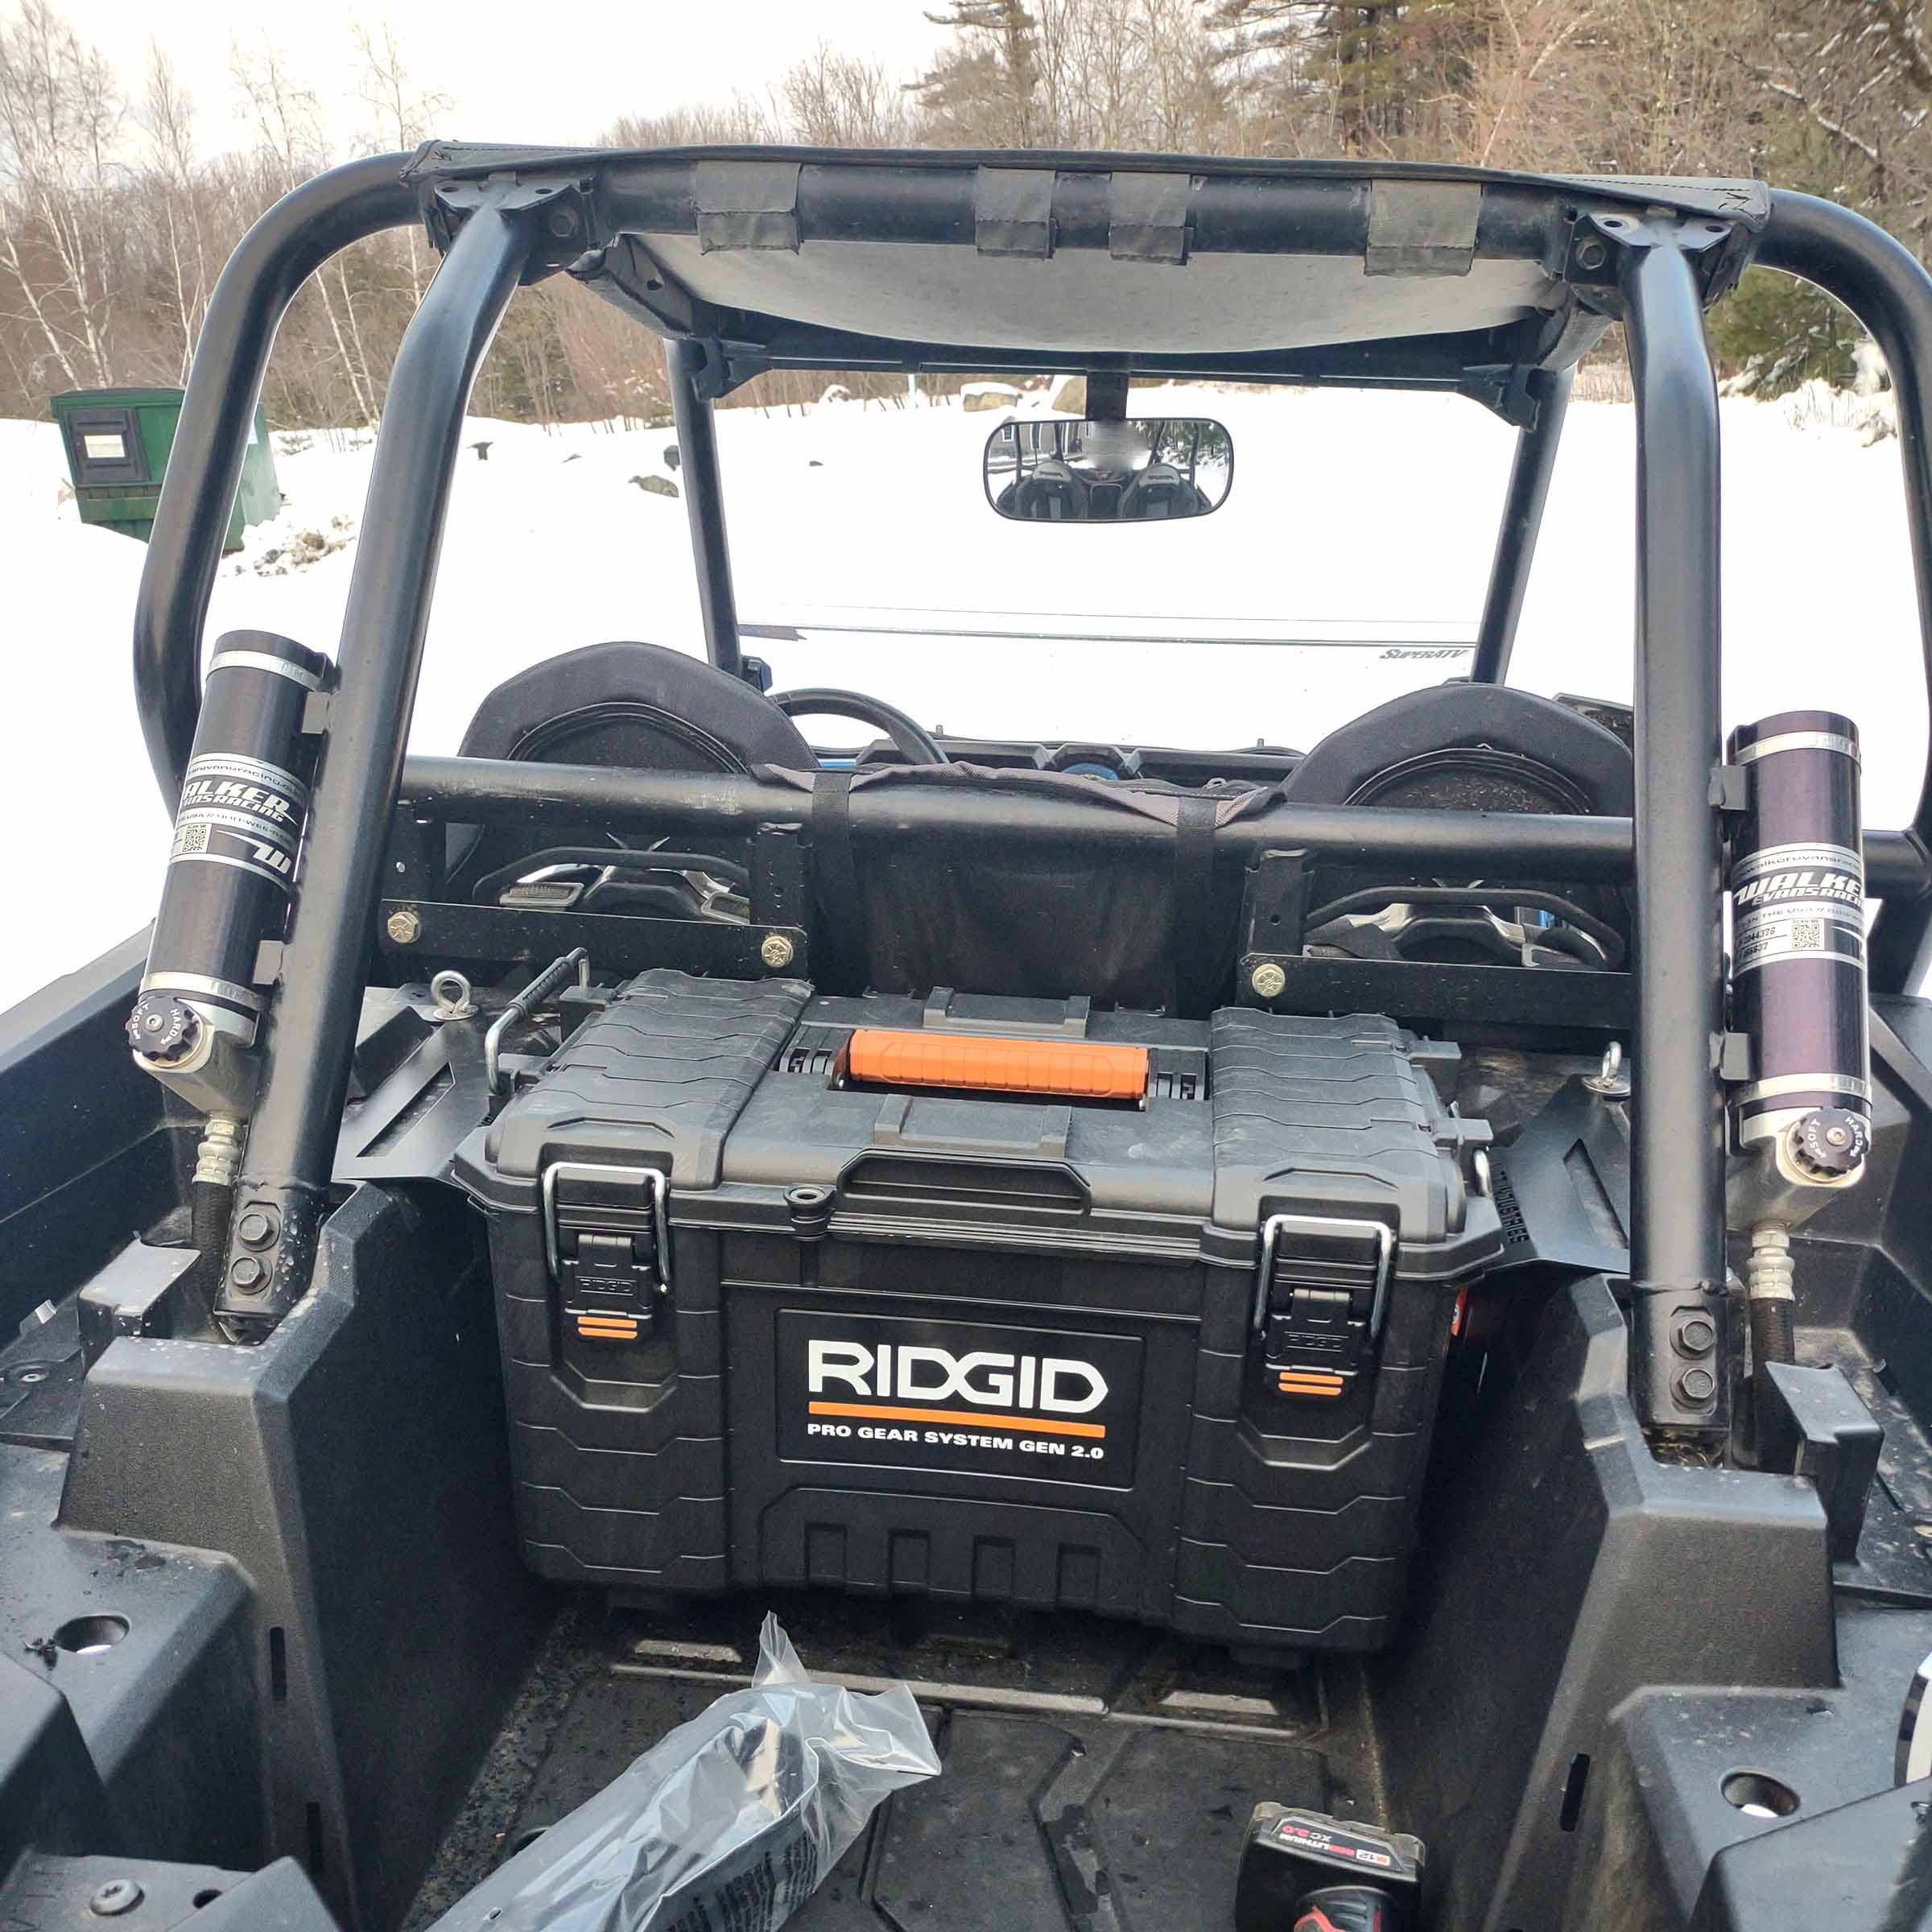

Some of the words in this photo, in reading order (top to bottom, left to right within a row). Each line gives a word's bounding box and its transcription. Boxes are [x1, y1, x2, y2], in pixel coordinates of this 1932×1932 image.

[184, 780, 295, 820] ALKER
[1732, 872, 1861, 906] WALKE
[170, 1009, 181, 1037] HARD
[1808, 1118, 1821, 1149] SOFT
[1844, 1117, 1863, 1146] HARD
[808, 1340, 1108, 1414] RIDGID
[807, 1423, 852, 1438] PRO
[858, 1426, 918, 1442] GEAR
[925, 1431, 1013, 1450] SYSTEM
[1019, 1439, 1065, 1455] GEN
[1071, 1446, 1104, 1459] 2.0
